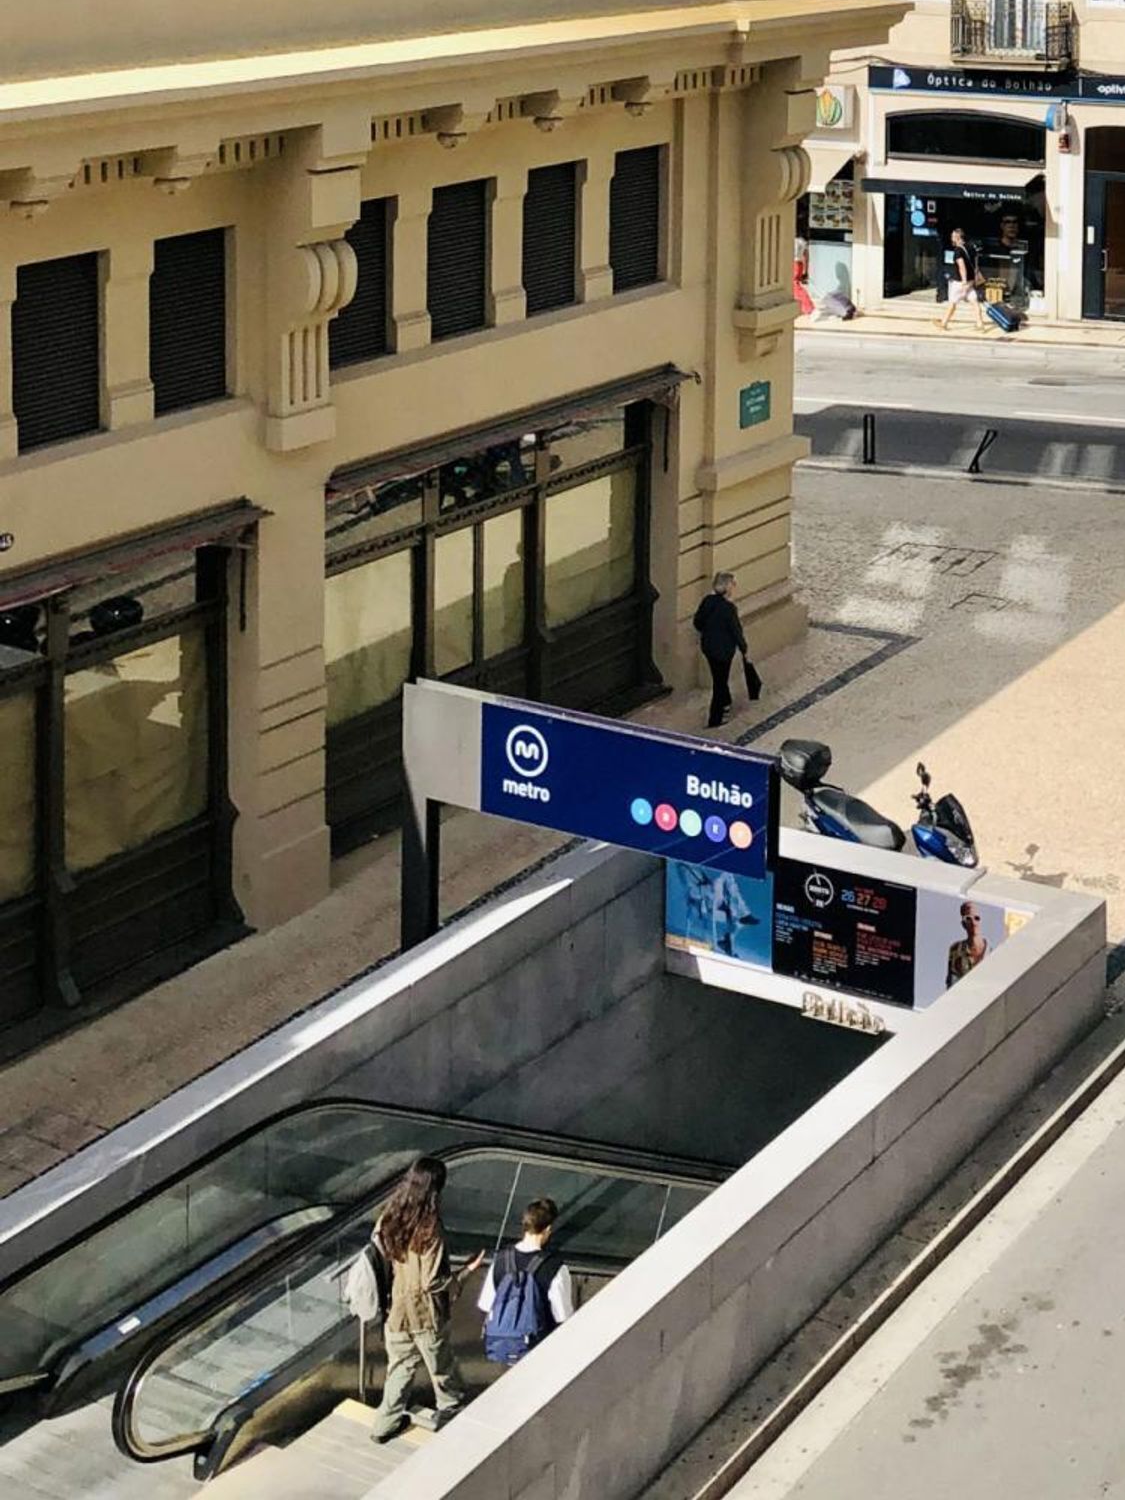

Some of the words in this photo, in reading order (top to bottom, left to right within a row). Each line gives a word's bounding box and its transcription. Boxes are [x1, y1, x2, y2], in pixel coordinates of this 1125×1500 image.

[503, 778, 551, 803] metro
[686, 775, 753, 809] Bolhão
[856, 892, 871, 906] 27
